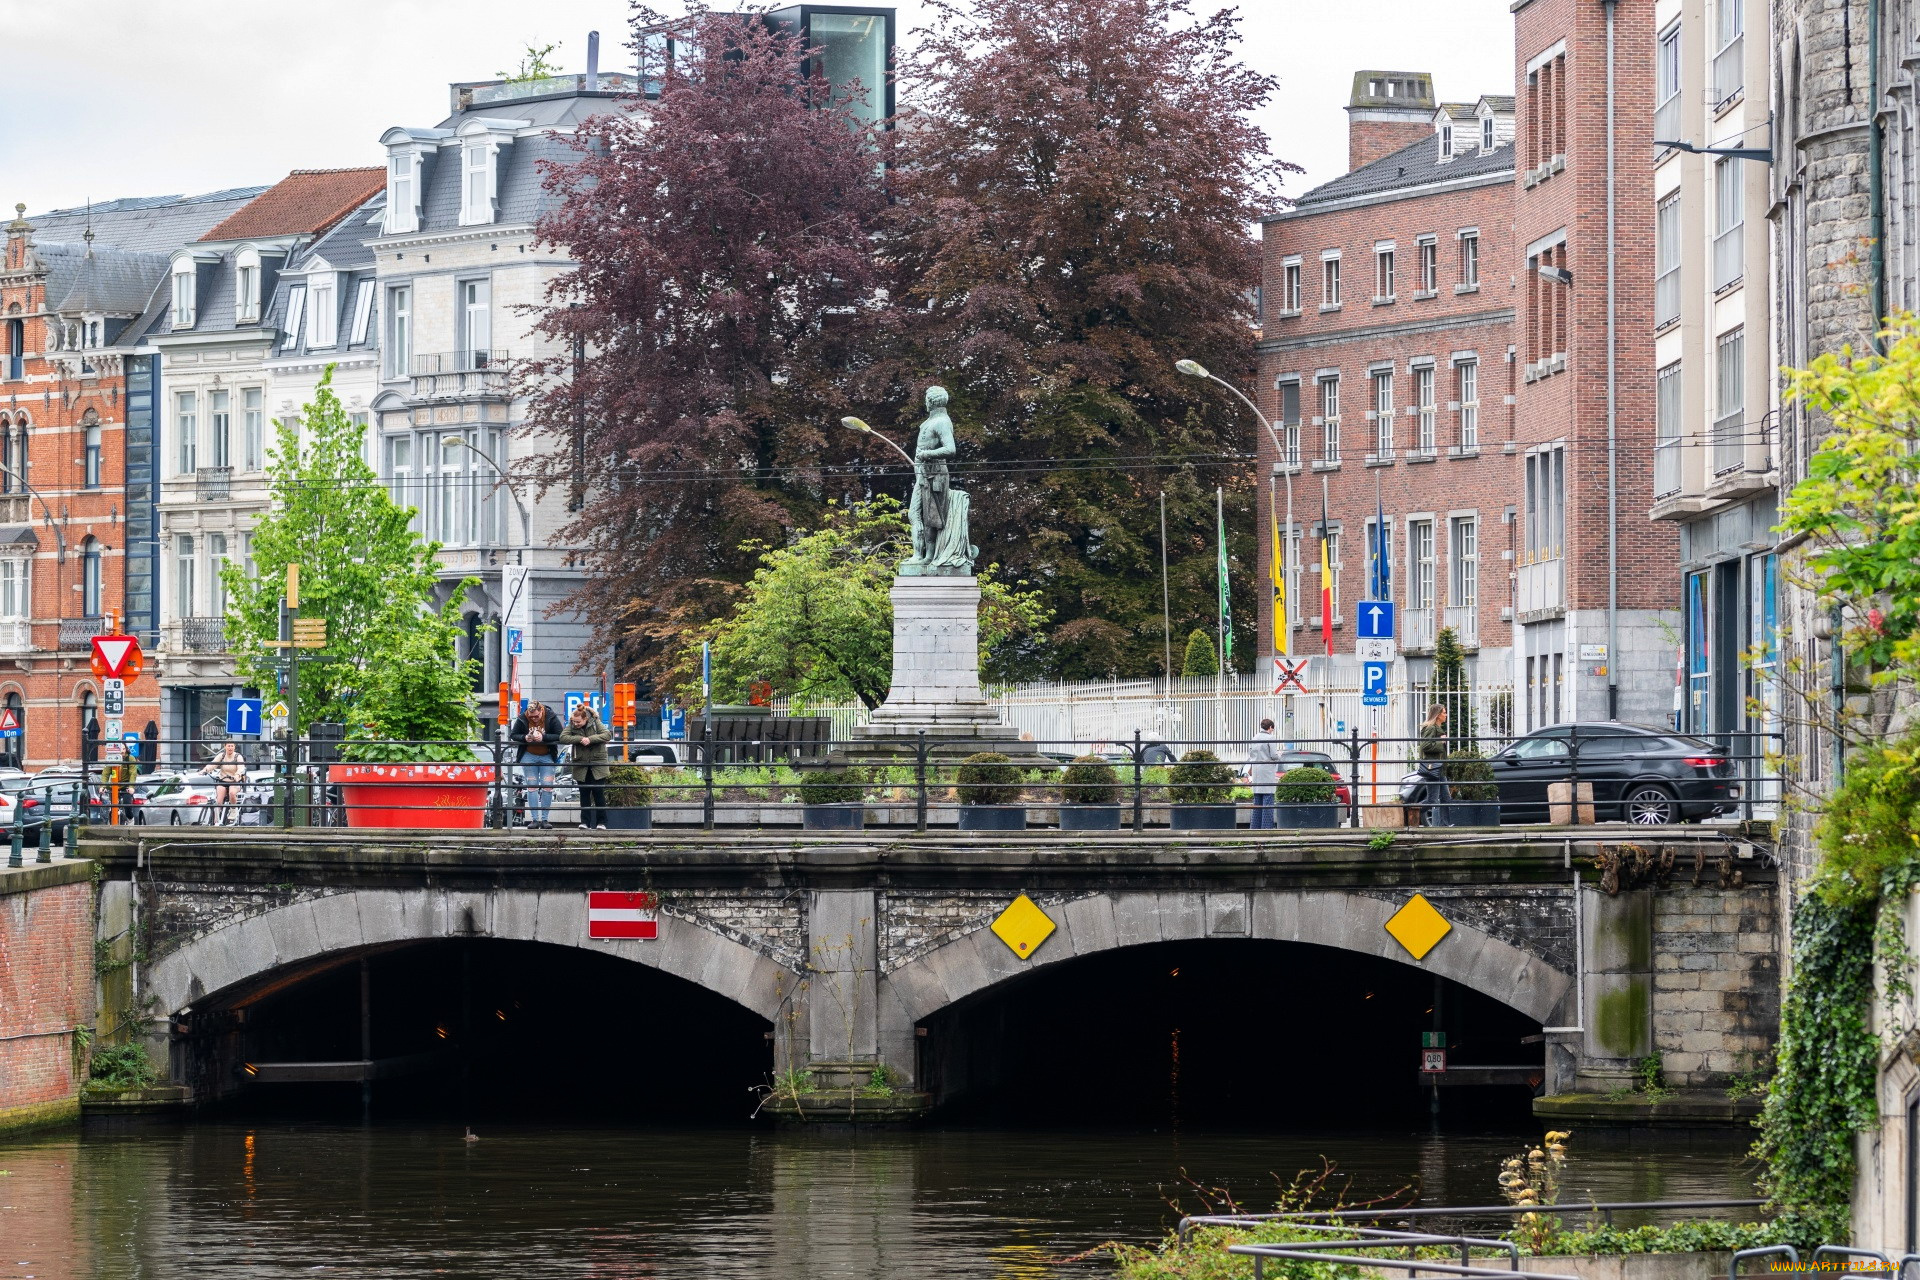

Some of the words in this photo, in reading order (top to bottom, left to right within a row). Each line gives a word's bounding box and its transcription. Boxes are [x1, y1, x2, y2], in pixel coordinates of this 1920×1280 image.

[508, 567, 524, 576] ZONE
[1367, 666, 1383, 690] P
[671, 709, 683, 726] P
[1426, 1055, 1442, 1064] 0,80
